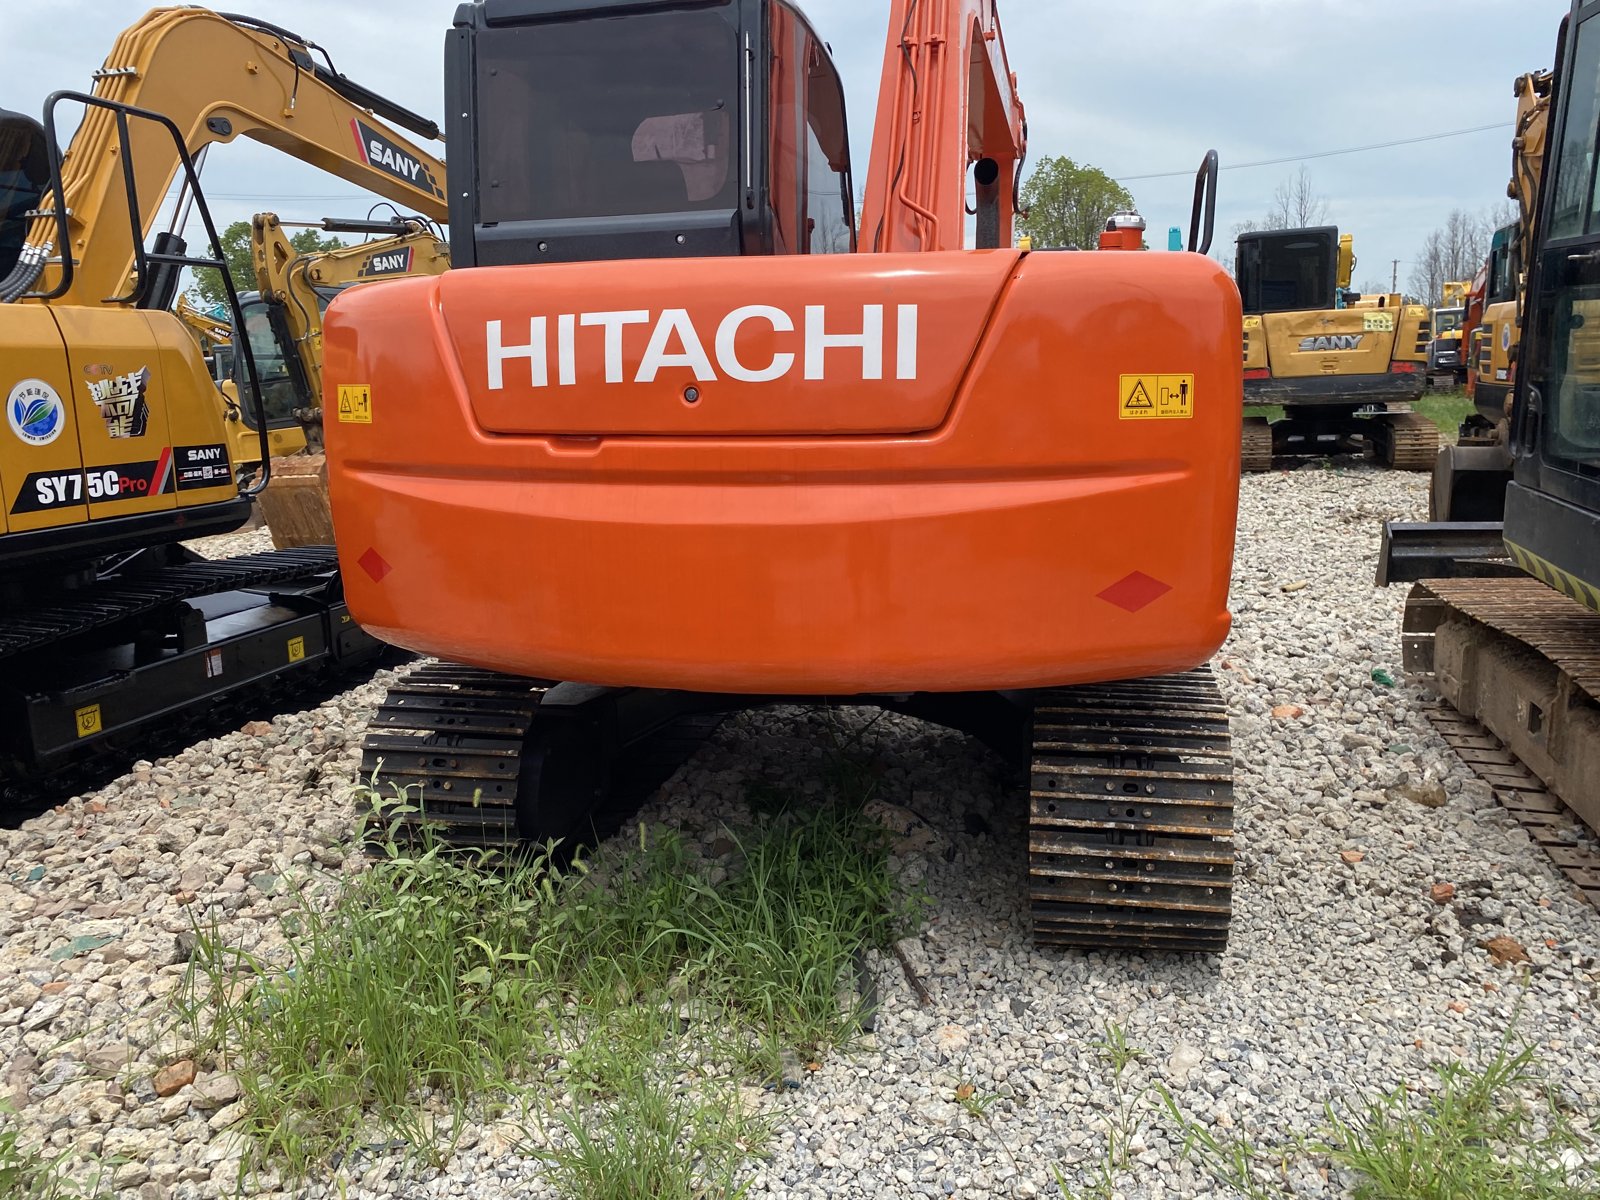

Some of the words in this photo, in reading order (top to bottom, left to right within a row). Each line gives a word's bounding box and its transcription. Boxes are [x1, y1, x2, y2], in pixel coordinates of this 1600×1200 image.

[369, 140, 421, 181] SANY
[373, 254, 405, 272] SANY
[214, 327, 230, 337] SANY
[485, 304, 919, 391] HITACHI
[1299, 334, 1364, 352] SANY
[187, 448, 221, 461] SANY
